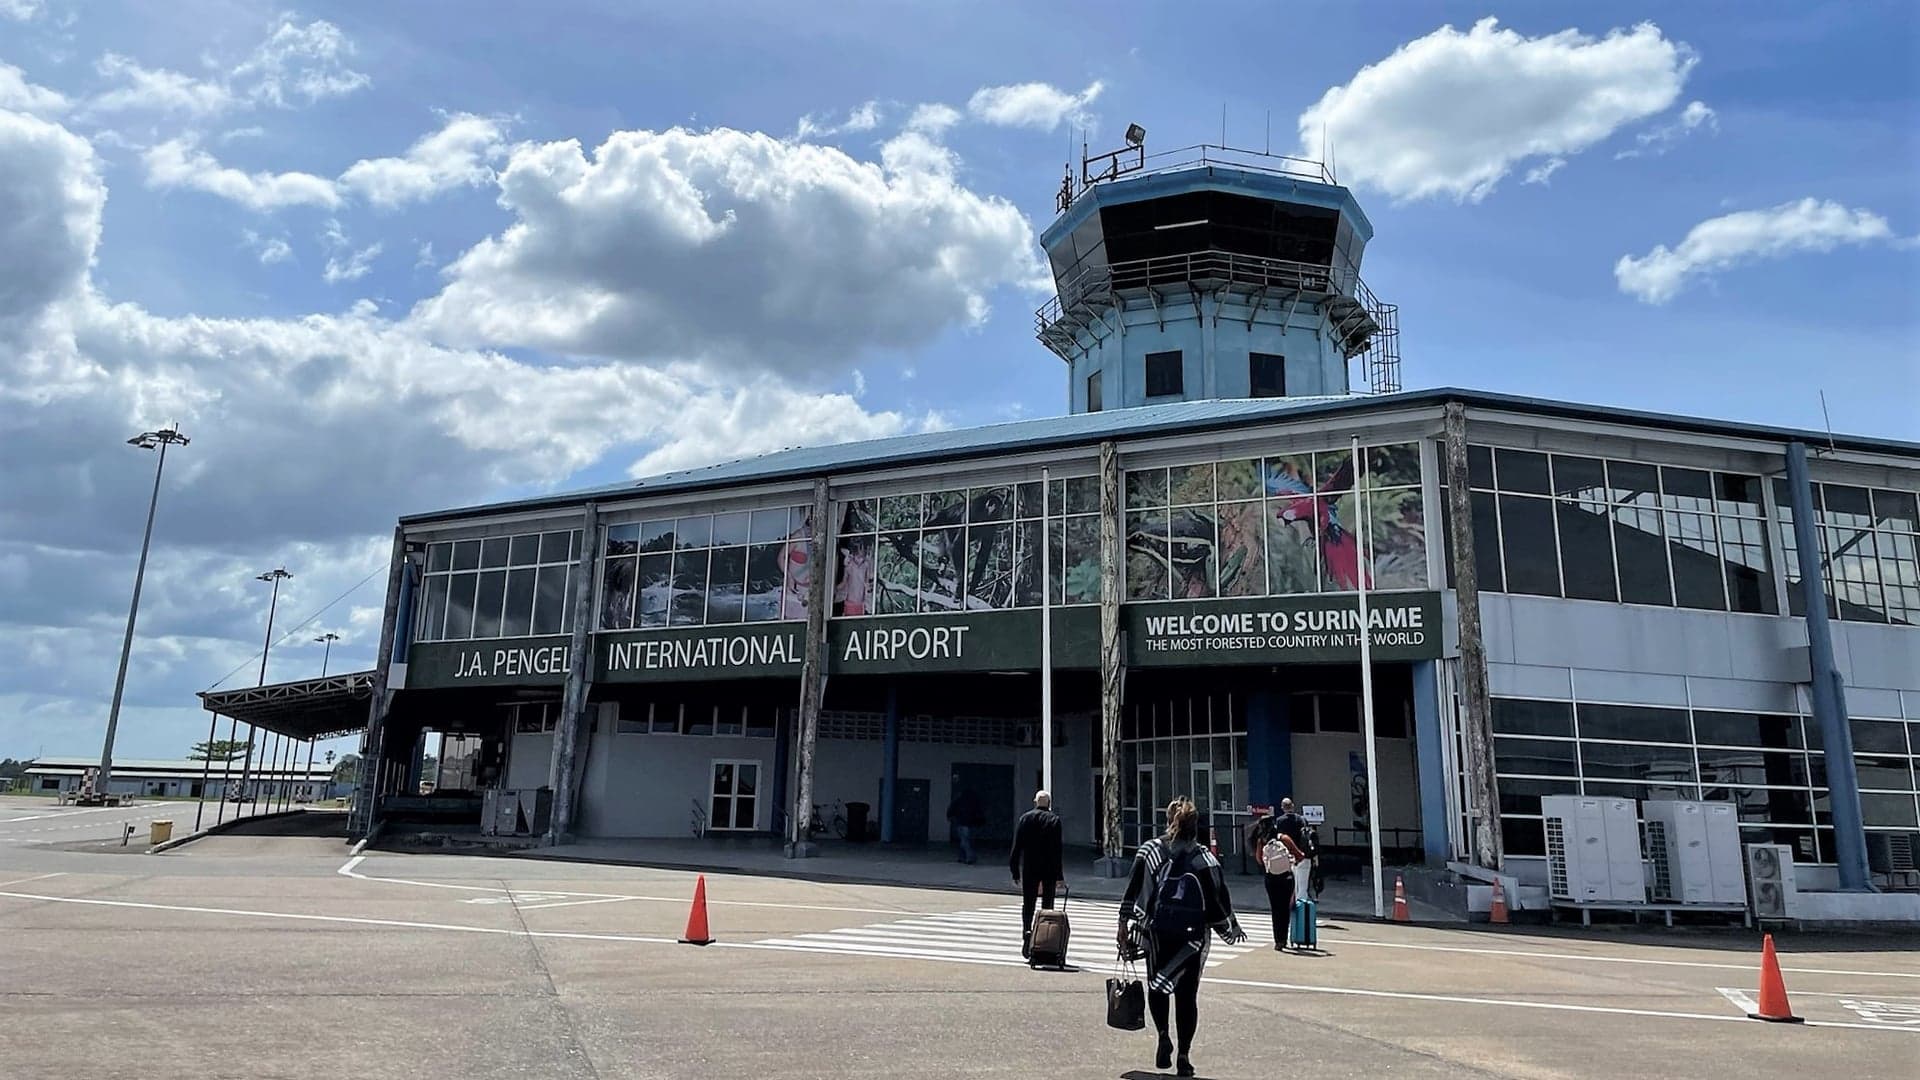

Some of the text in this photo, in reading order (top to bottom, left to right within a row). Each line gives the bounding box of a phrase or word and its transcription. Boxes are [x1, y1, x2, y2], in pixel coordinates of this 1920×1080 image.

[1145, 606, 1423, 636] WELCOME TO SURINAME
[454, 626, 969, 677] J.A. PENGEL INTERNATIONAL AIRPORT
[1146, 639, 1168, 651] THE
[1170, 638, 1203, 650] MOST
[1205, 636, 1265, 649] FORESTED
[1268, 634, 1328, 648] COUNTRY
[1330, 634, 1344, 647] IN
[1373, 631, 1424, 645] WORLD
